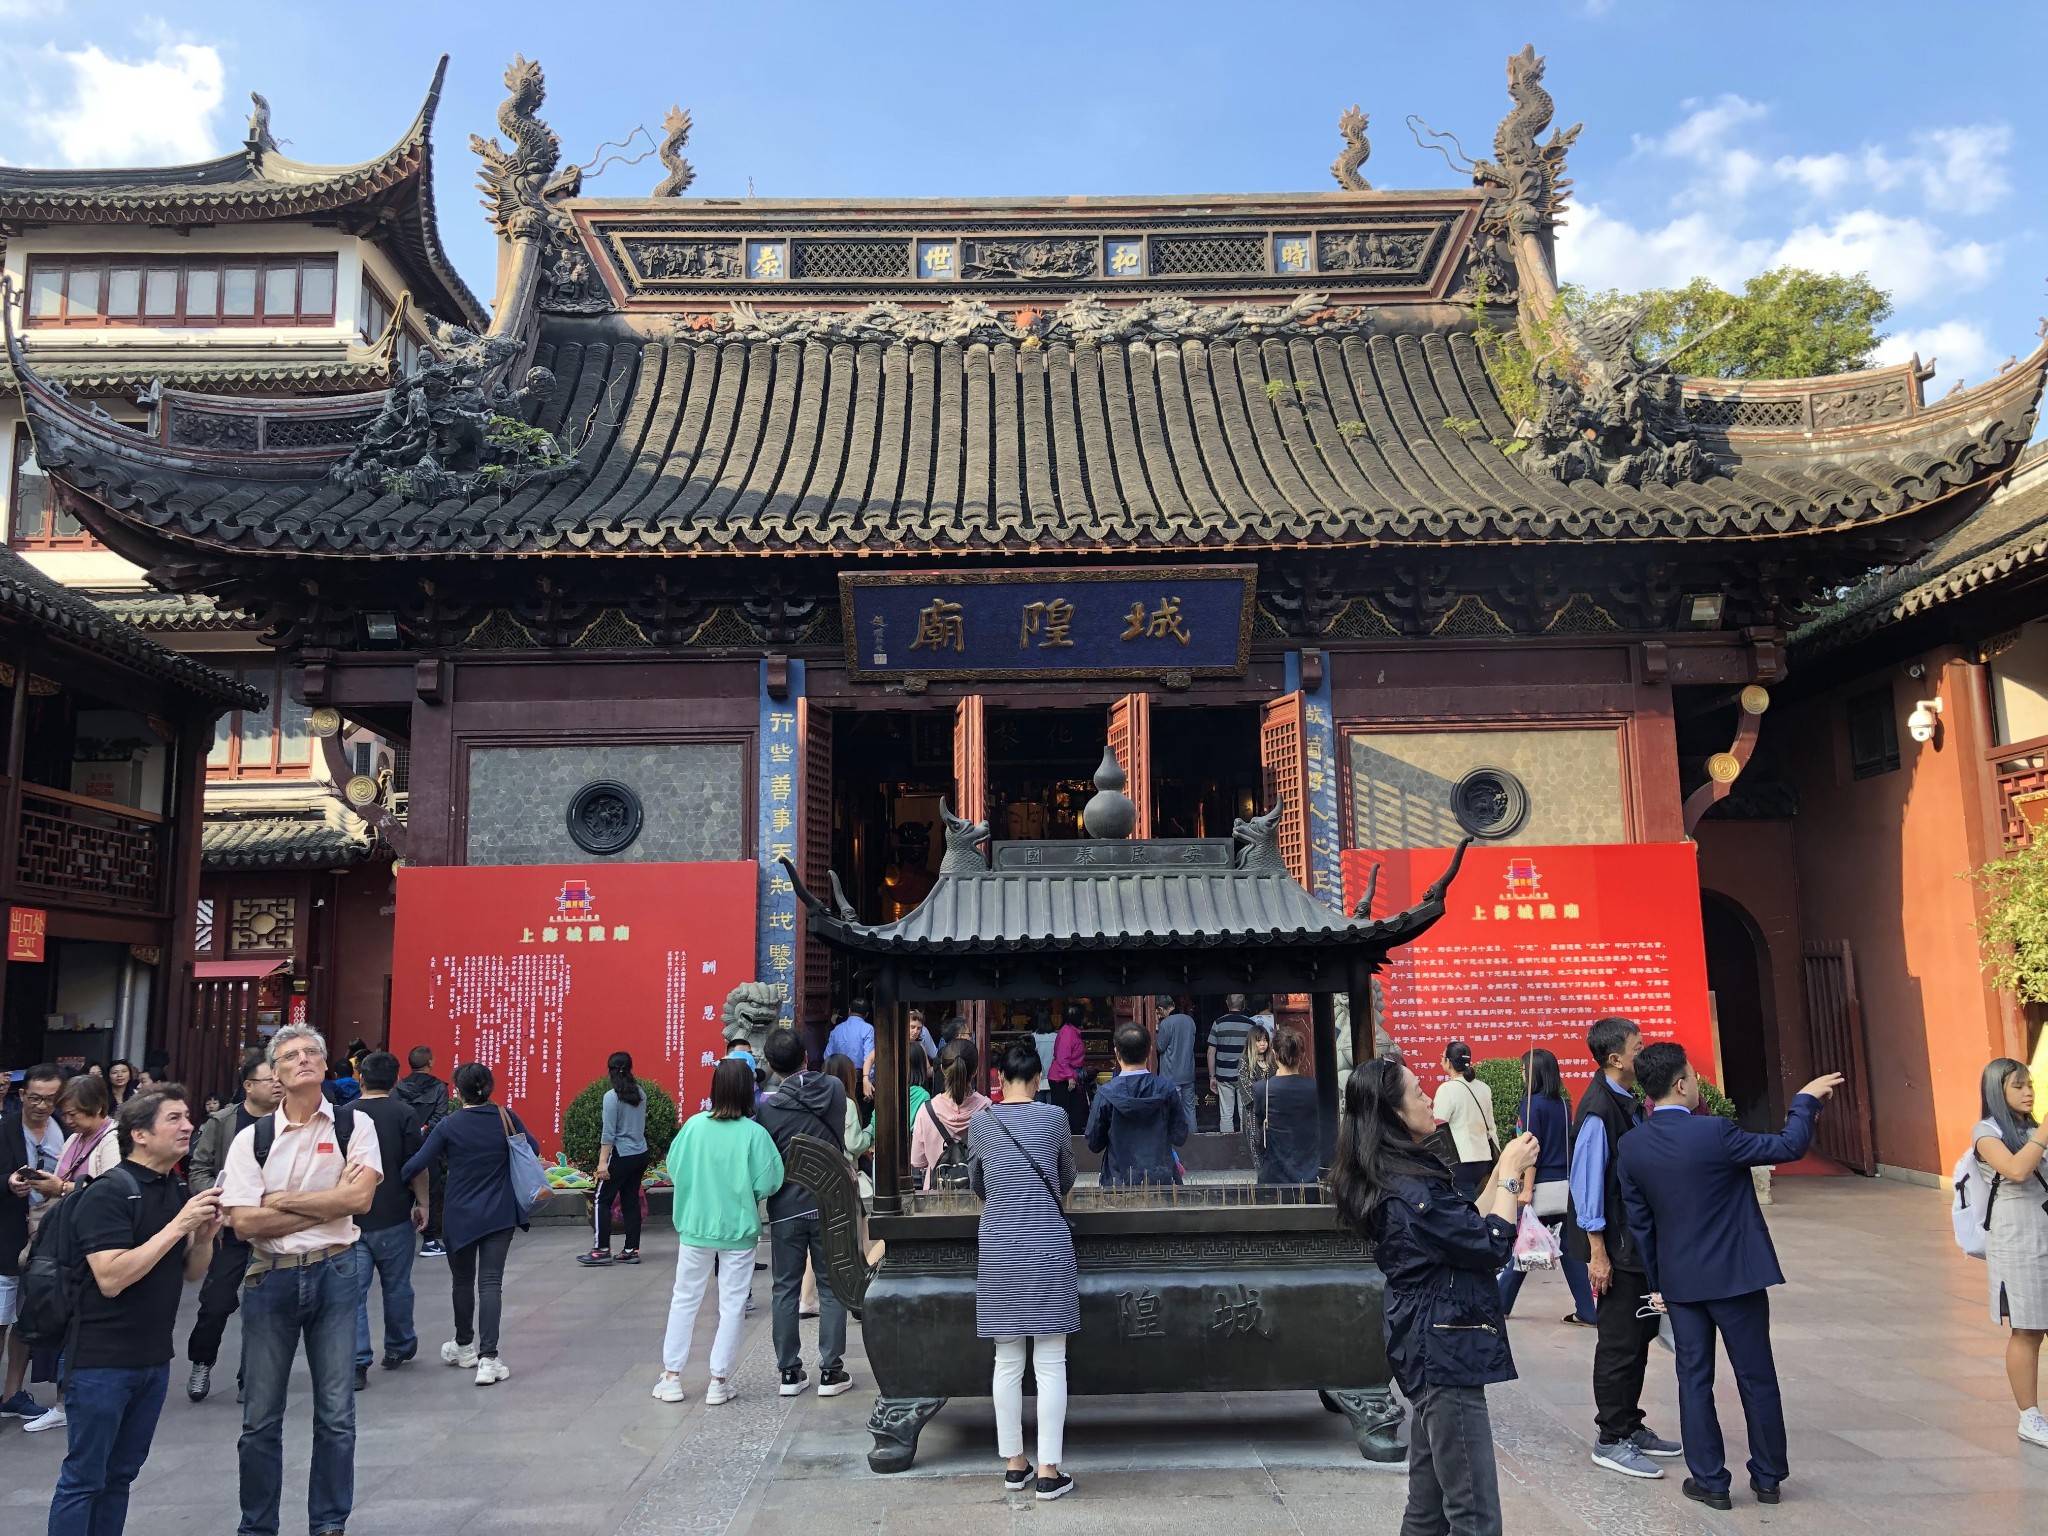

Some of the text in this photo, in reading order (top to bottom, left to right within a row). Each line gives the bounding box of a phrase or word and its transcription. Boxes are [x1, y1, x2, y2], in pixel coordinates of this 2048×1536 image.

[1025, 845, 1204, 866] 國泰民安
[11, 910, 44, 936] 出口处
[18, 936, 36, 948] EXIT
